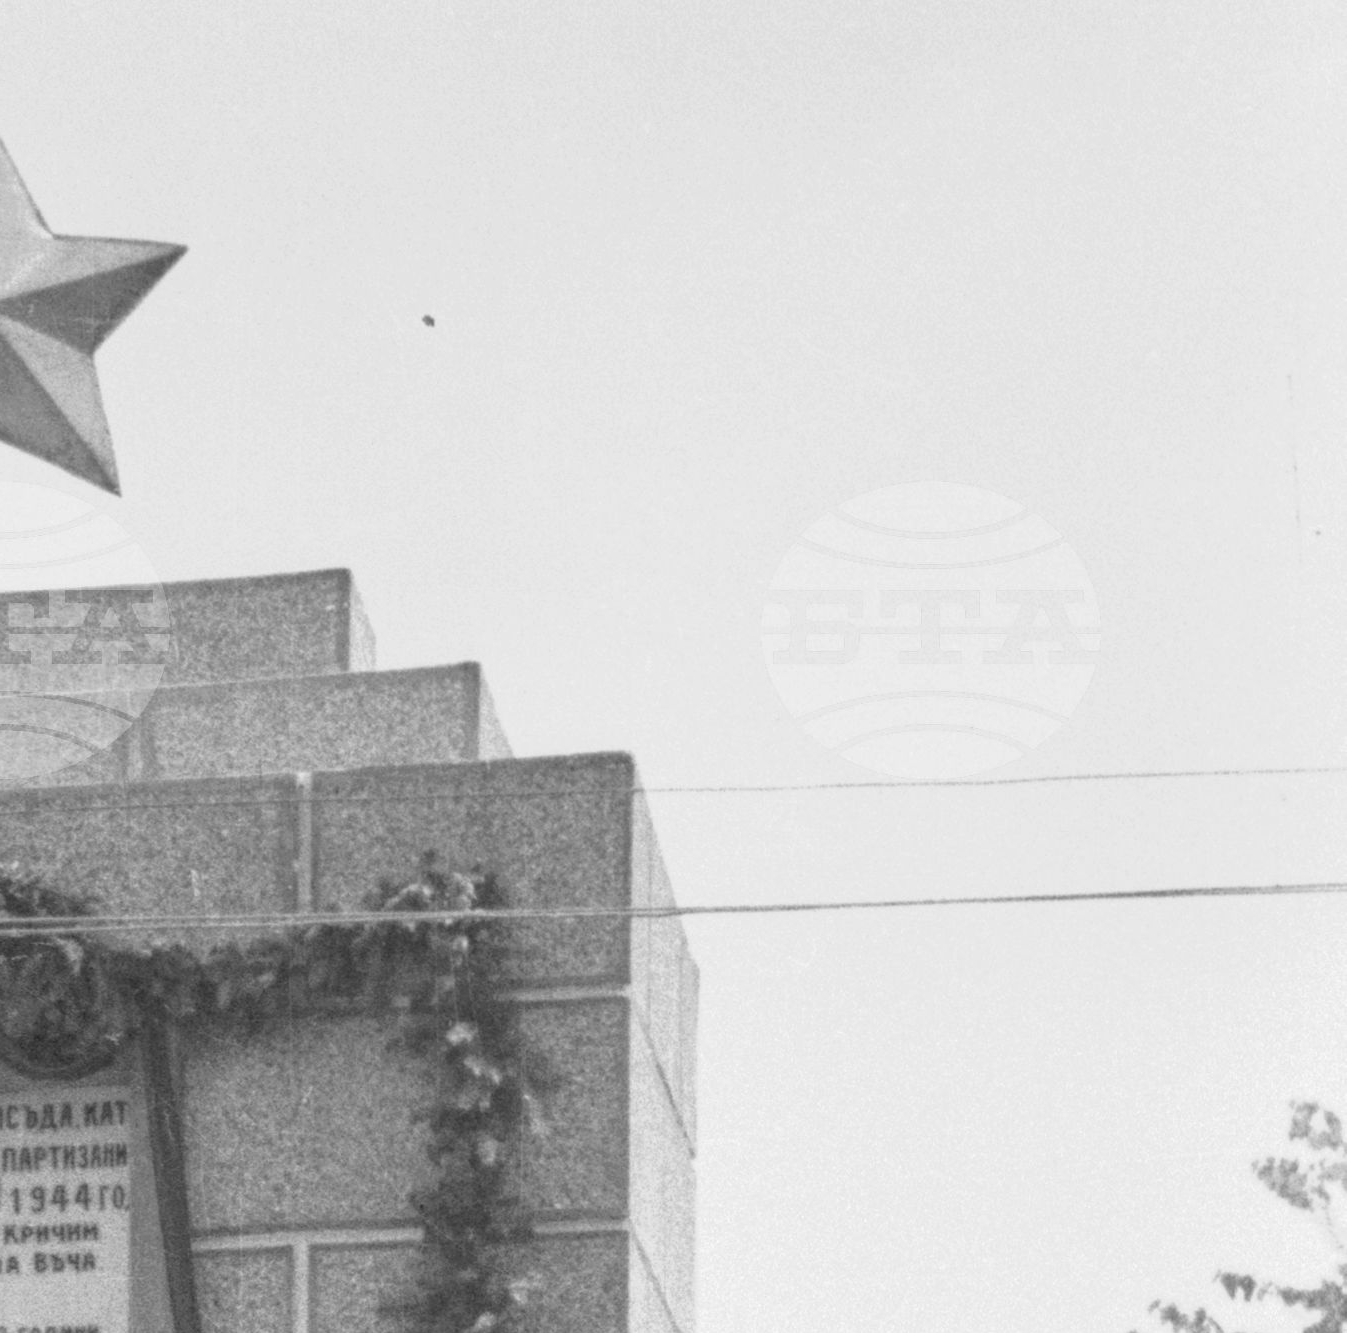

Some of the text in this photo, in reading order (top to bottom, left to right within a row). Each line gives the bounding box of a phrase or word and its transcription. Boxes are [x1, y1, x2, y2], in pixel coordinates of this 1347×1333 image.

[84, 1101, 127, 1127] КАТ
[3, 1144, 128, 1172] ПАРТИЗАНИ
[11, 1183, 90, 1214] 1944
[4, 1224, 99, 1245] КРИЧИМ
[34, 1252, 95, 1273] ВЪЧА
